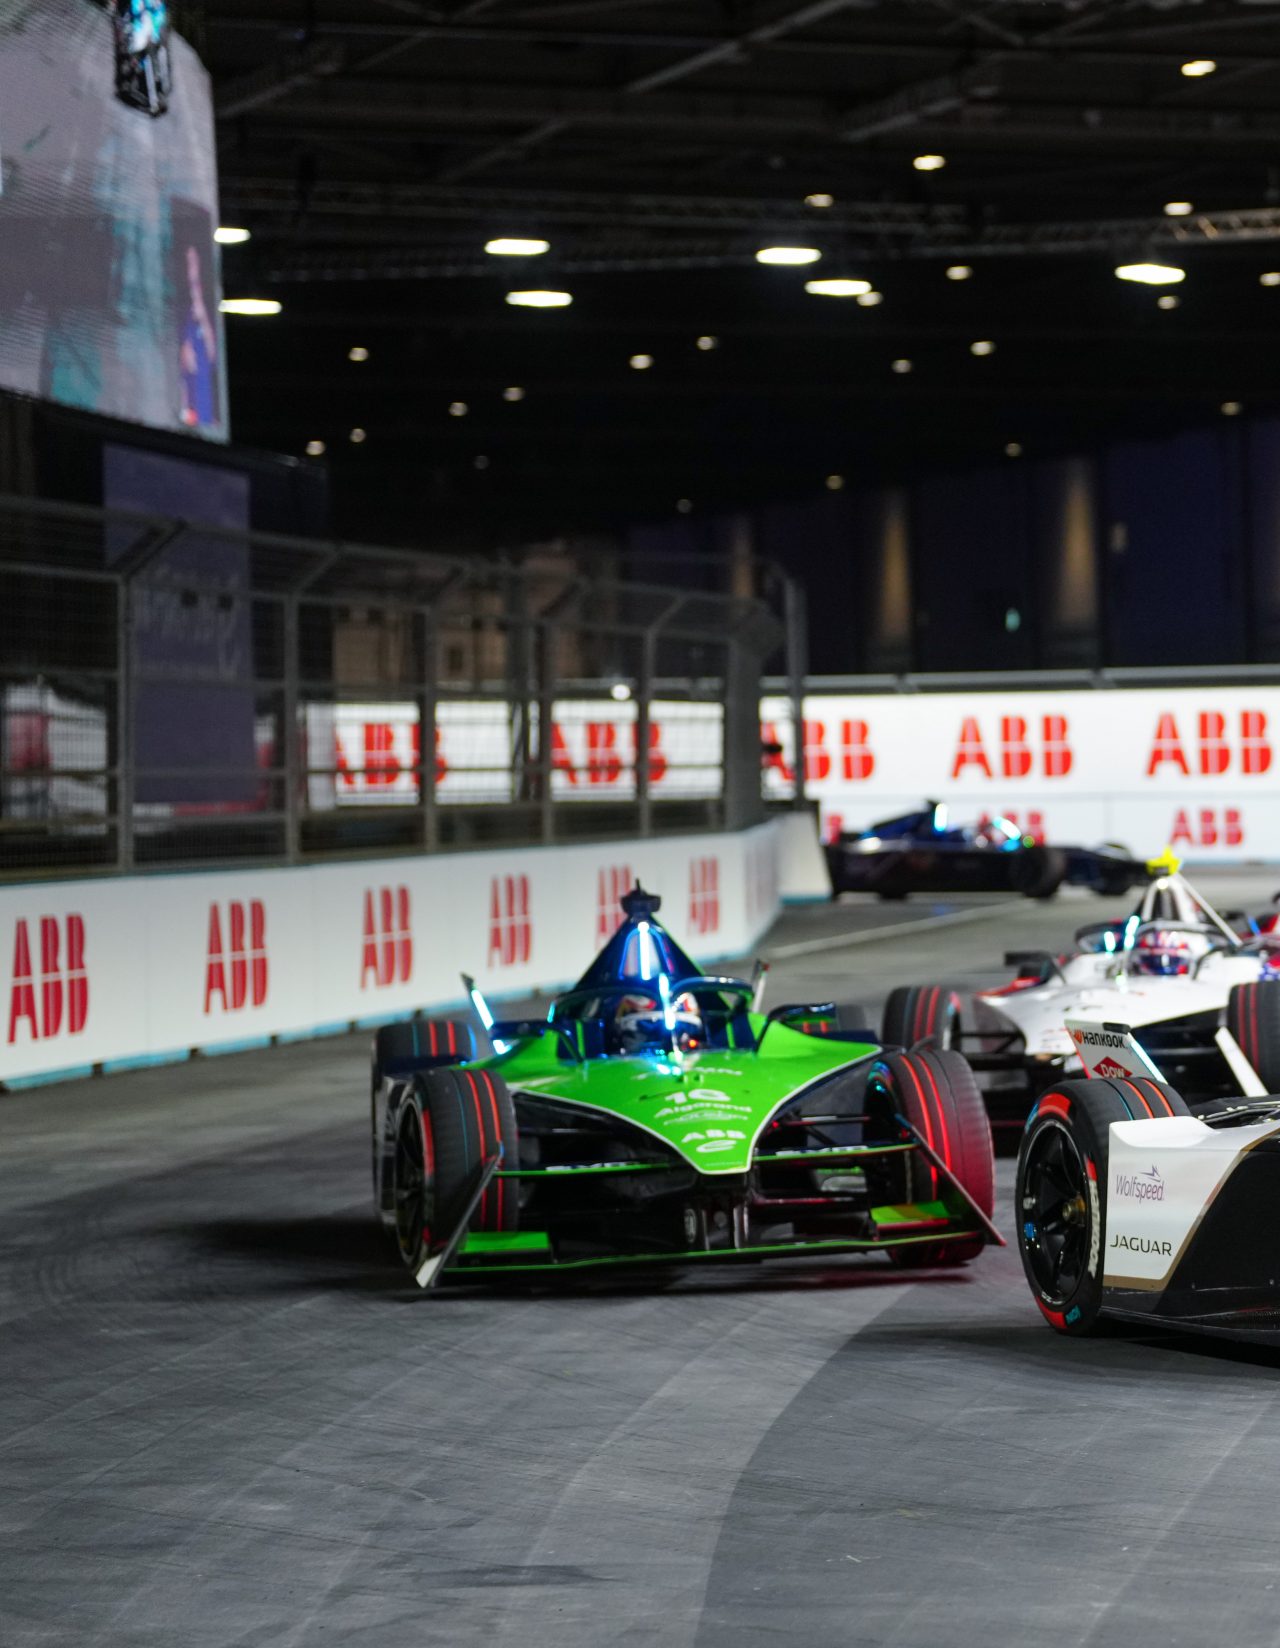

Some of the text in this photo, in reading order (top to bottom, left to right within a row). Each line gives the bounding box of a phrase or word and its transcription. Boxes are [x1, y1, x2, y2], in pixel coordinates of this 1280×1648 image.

[952, 714, 1073, 778] ABB
[1147, 710, 1272, 776] ABB
[1170, 808, 1243, 846] ABB
[488, 872, 531, 970] ABB
[688, 856, 718, 935] ABB
[204, 898, 269, 1014] ABB
[361, 884, 414, 990] ABB
[8, 912, 90, 1045] ABB
[1116, 1174, 1165, 1203] Wolfspeed
[1110, 1235, 1172, 1256] JAGUAR
